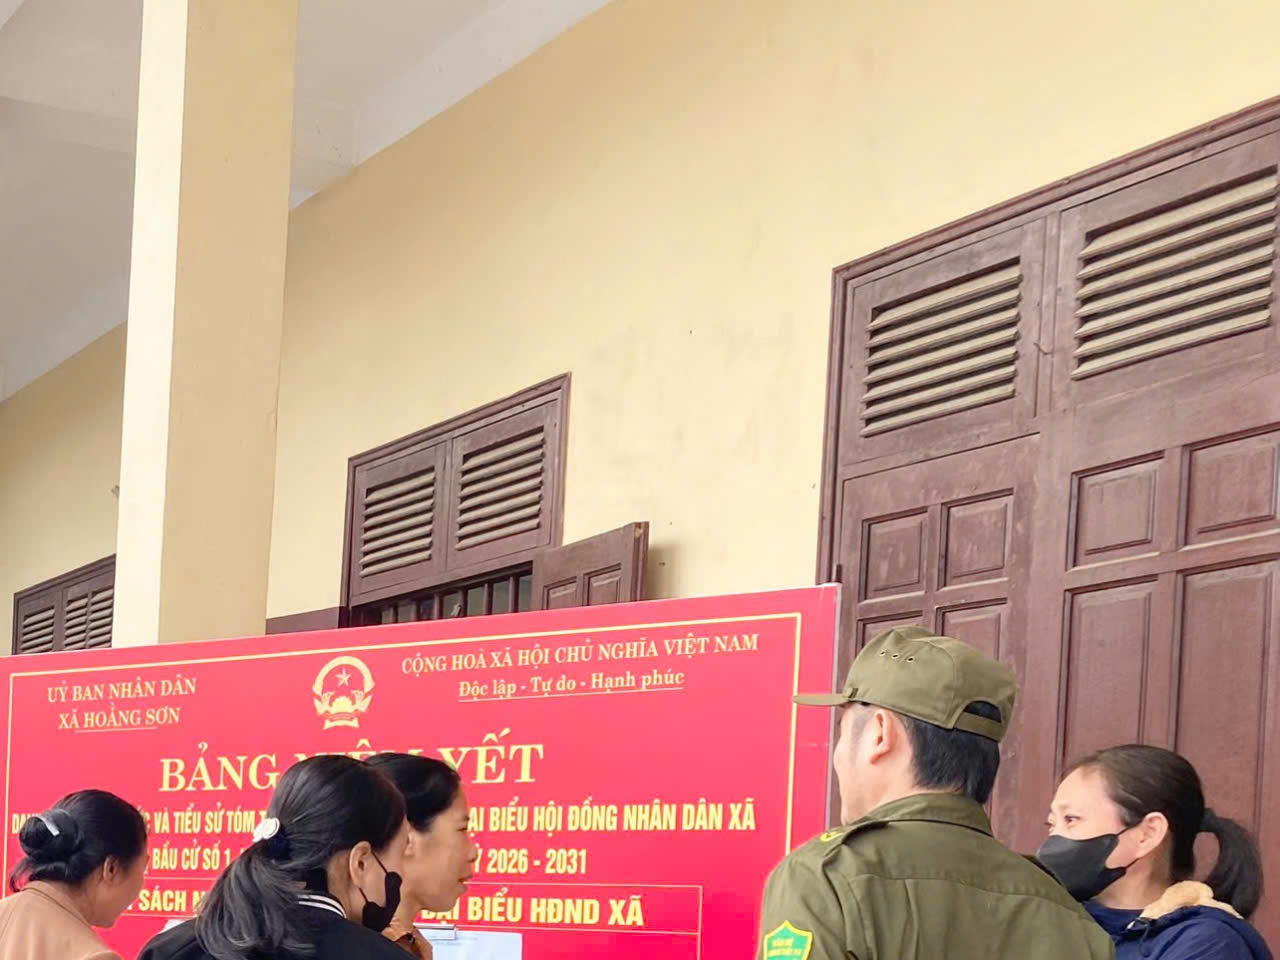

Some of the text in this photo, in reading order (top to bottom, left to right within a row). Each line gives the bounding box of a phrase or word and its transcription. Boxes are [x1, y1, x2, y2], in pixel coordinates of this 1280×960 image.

[401, 633, 760, 678] CỘNG HOÀ XÃ HỘI CHỦ NGHĨA VIỆT NAM
[48, 673, 197, 703] UỶ BAN NHÂN DÂN
[458, 679, 489, 701] Độc
[492, 678, 517, 700] lập
[530, 676, 552, 697] Tự
[556, 673, 577, 691] do
[591, 670, 637, 695] Hạnh
[640, 667, 685, 689] phúc
[58, 708, 80, 730] XÃ
[145, 704, 181, 725] SƠN
[158, 727, 545, 793] BẢNG YẾT
[153, 808, 170, 834] VÀ
[173, 802, 201, 834] TIỂU
[204, 800, 225, 834] SỬ
[227, 804, 255, 833] TÓM
[467, 795, 756, 838] ẠI BIỂU HỘI ĐỒNG NHÂN DÂN XÃ
[152, 839, 178, 871] BẦU
[181, 837, 201, 871] CỬ
[202, 839, 221, 871] SỐ
[486, 847, 529, 874] 2026
[545, 847, 587, 874] 2031
[138, 885, 187, 912] SÁCH
[467, 887, 523, 923] BIỂU
[530, 896, 600, 924] HĐND
[608, 894, 645, 927] XÃ
